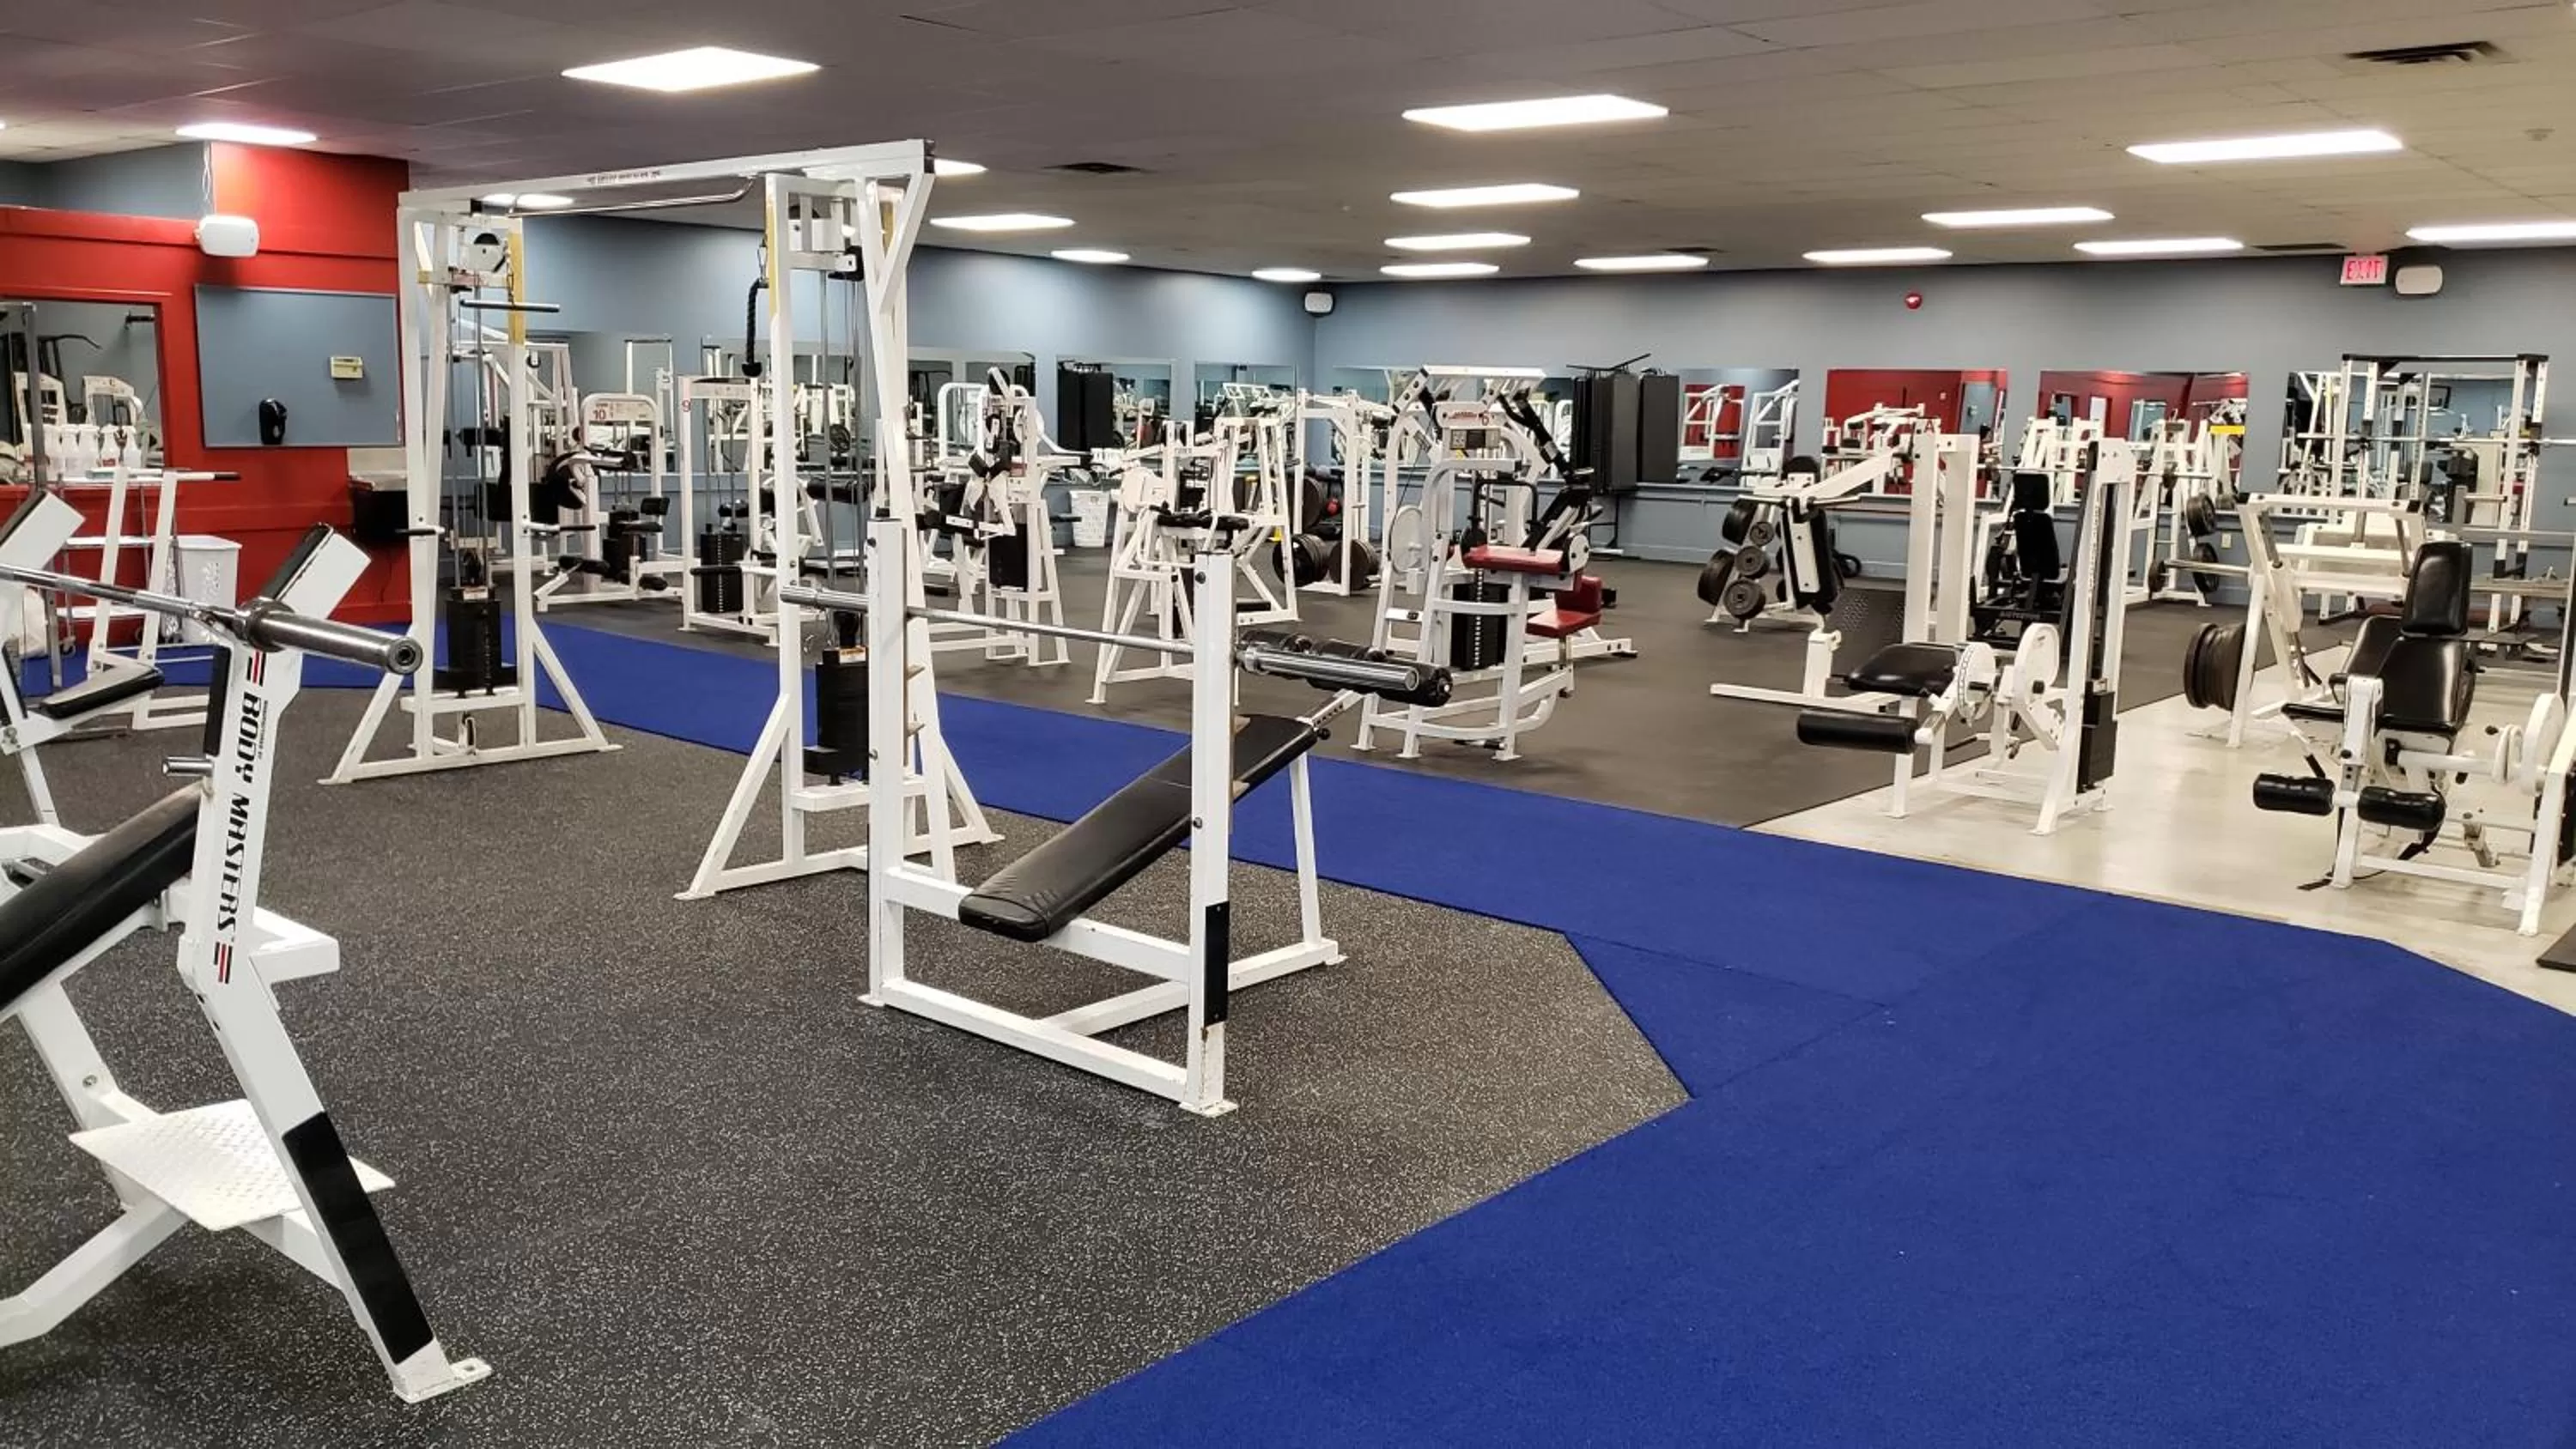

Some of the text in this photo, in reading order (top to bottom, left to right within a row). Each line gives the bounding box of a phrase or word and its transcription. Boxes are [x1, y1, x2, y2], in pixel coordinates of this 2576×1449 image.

[2346, 260, 2382, 280] EXIT
[681, 399, 691, 412] 9
[593, 409, 606, 420] 10
[1481, 410, 1490, 426] 6
[1923, 420, 1935, 433] A
[217, 691, 261, 936] BODY MASTERS
